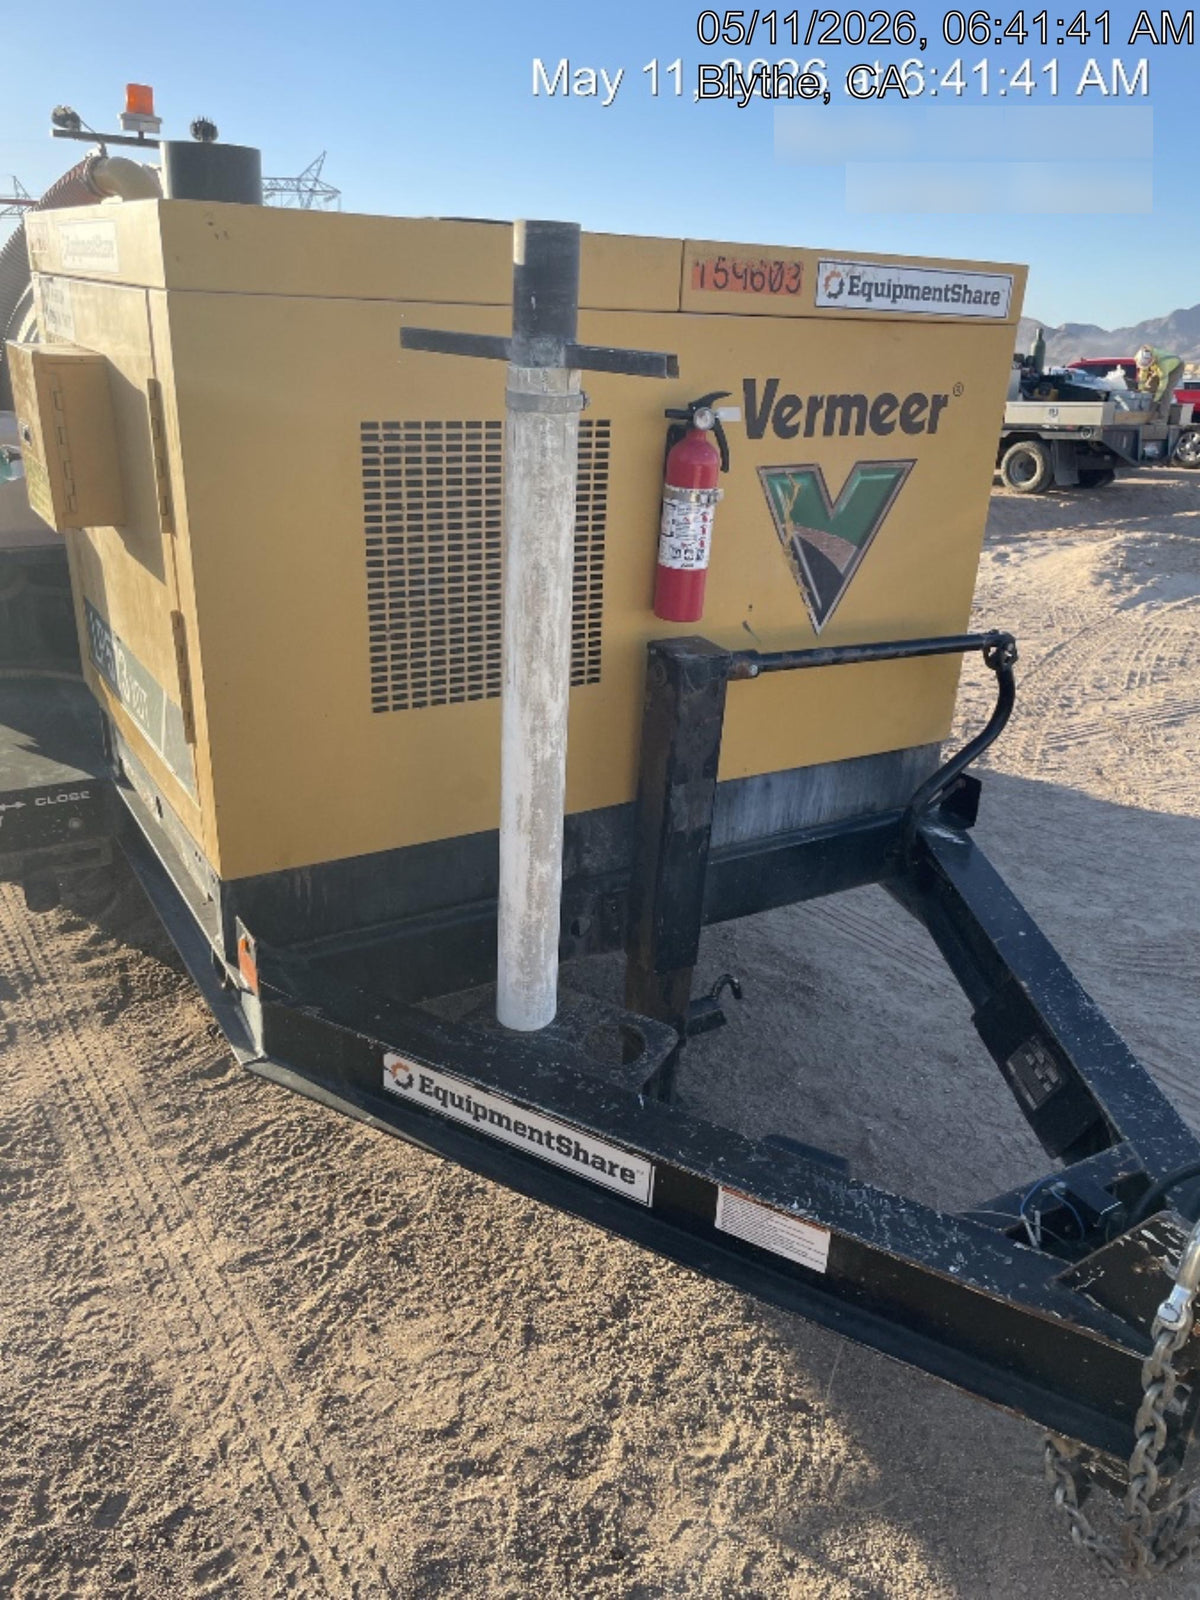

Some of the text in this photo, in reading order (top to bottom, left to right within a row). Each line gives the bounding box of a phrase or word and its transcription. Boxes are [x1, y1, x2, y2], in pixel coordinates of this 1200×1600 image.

[694, 256, 802, 295] 154603
[848, 275, 1001, 307] EquipmentShare
[743, 378, 949, 439] Vermeer
[419, 1073, 635, 1185] EquipmentShare
